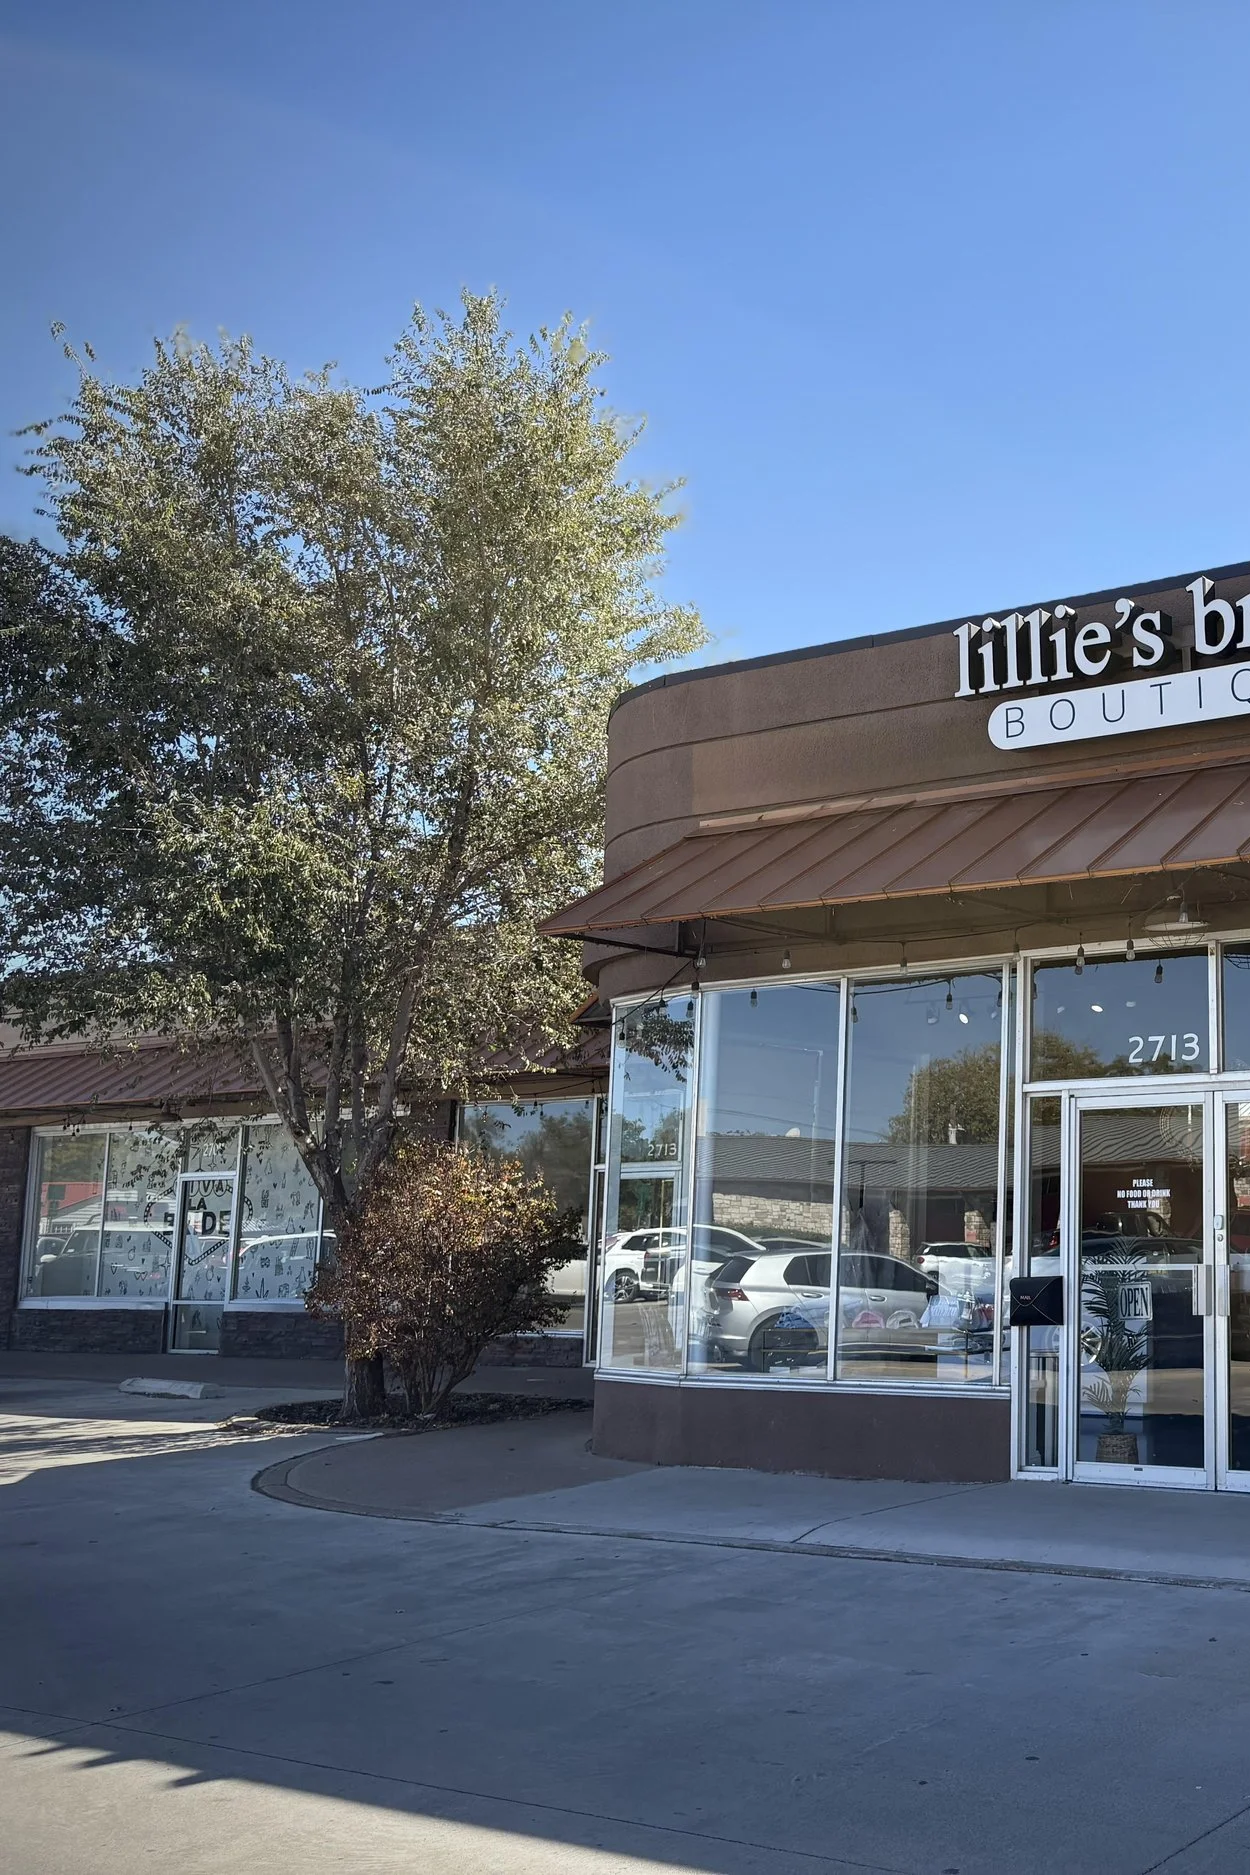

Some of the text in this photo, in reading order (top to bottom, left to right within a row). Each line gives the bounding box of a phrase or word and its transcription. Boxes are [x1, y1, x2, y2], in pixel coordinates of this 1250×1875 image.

[953, 597, 1168, 697] lillie's
[1128, 1033, 1200, 1063] 2713
[647, 1143, 677, 1156] 2713
[1132, 1179, 1154, 1188] PLEASE
[1116, 1190, 1126, 1198] NO
[1126, 1189, 1142, 1198] FOOD
[1142, 1189, 1151, 1198] OR
[1127, 1199, 1160, 1208] THANK YOU
[1120, 1287, 1149, 1318] OPEN
